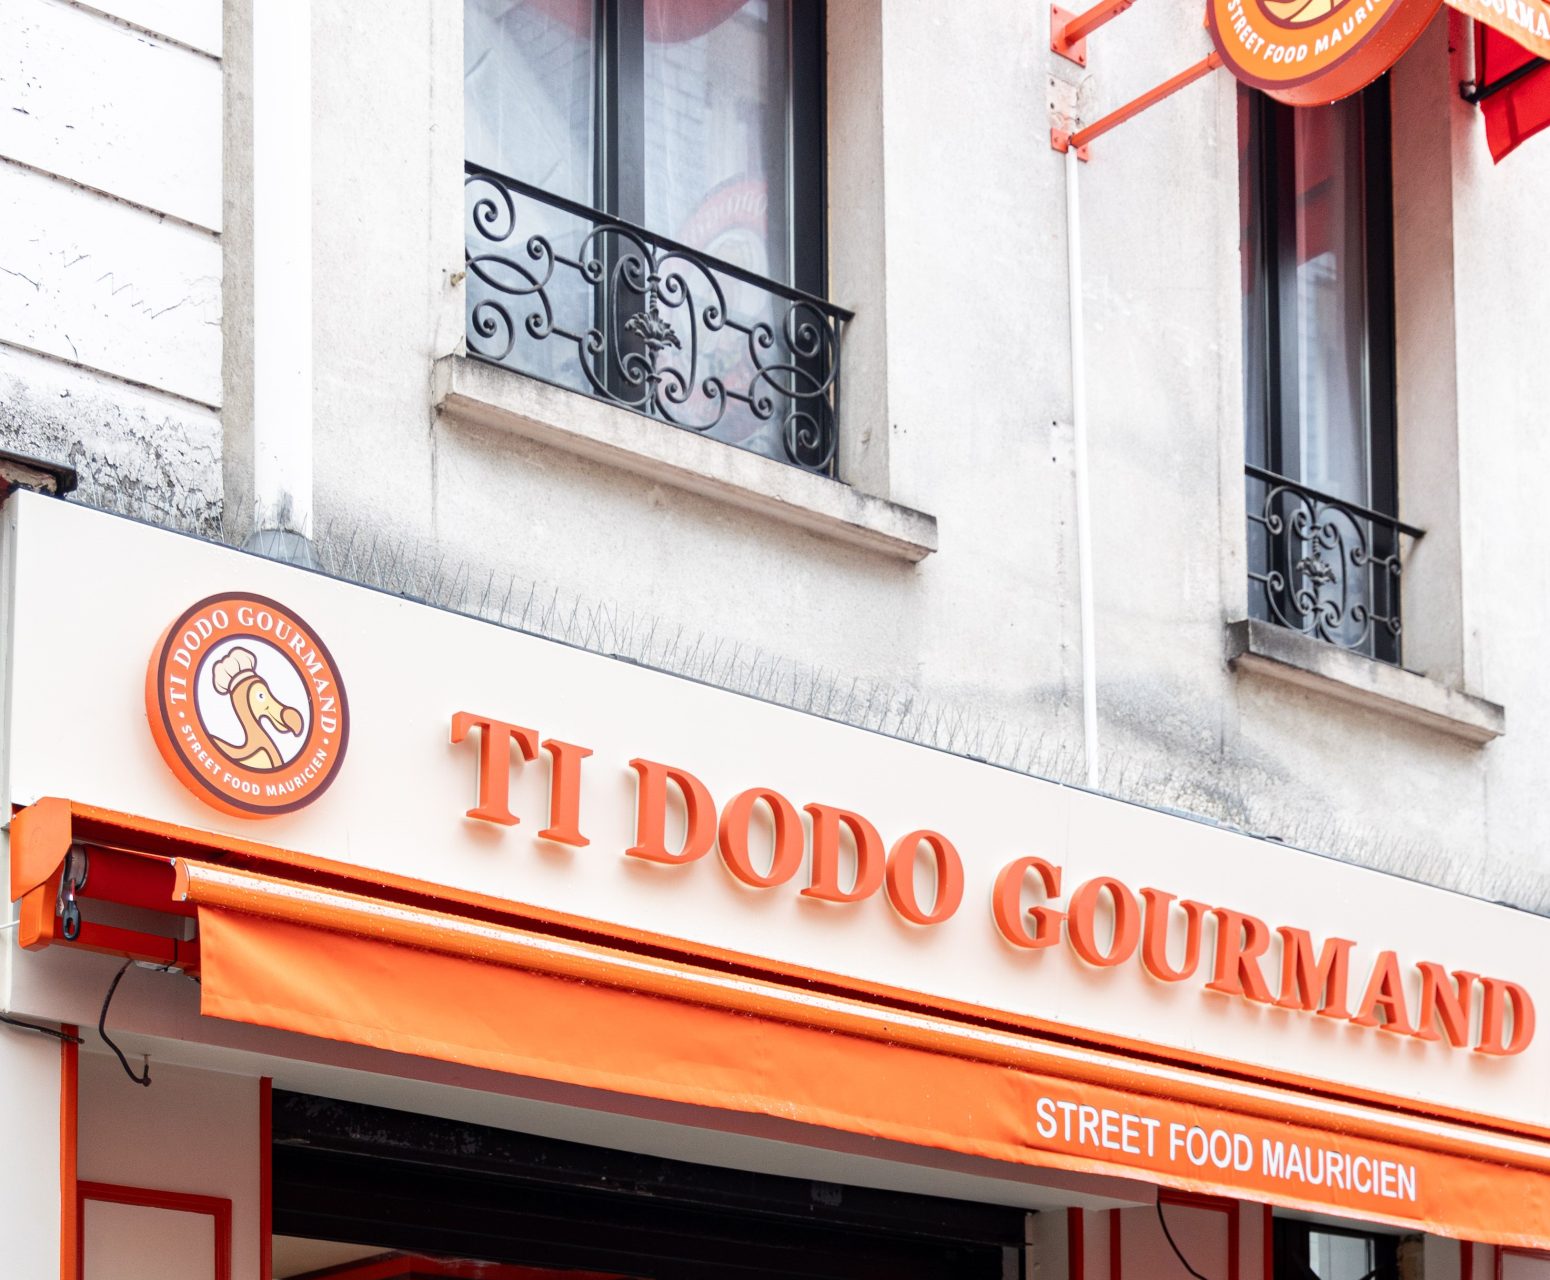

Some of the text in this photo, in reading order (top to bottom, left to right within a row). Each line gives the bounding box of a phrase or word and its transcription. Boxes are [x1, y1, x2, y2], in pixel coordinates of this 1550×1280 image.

[1227, 0, 1381, 64] STREET FOOD MAURI
[170, 606, 337, 734] TI DODO GOURMAND
[181, 724, 328, 797] STREET FOOD MAURICIEN
[450, 711, 1537, 1057] TI DODO GOURMAND
[1036, 1097, 1417, 1202] STREET FOOD MAURICIEN
